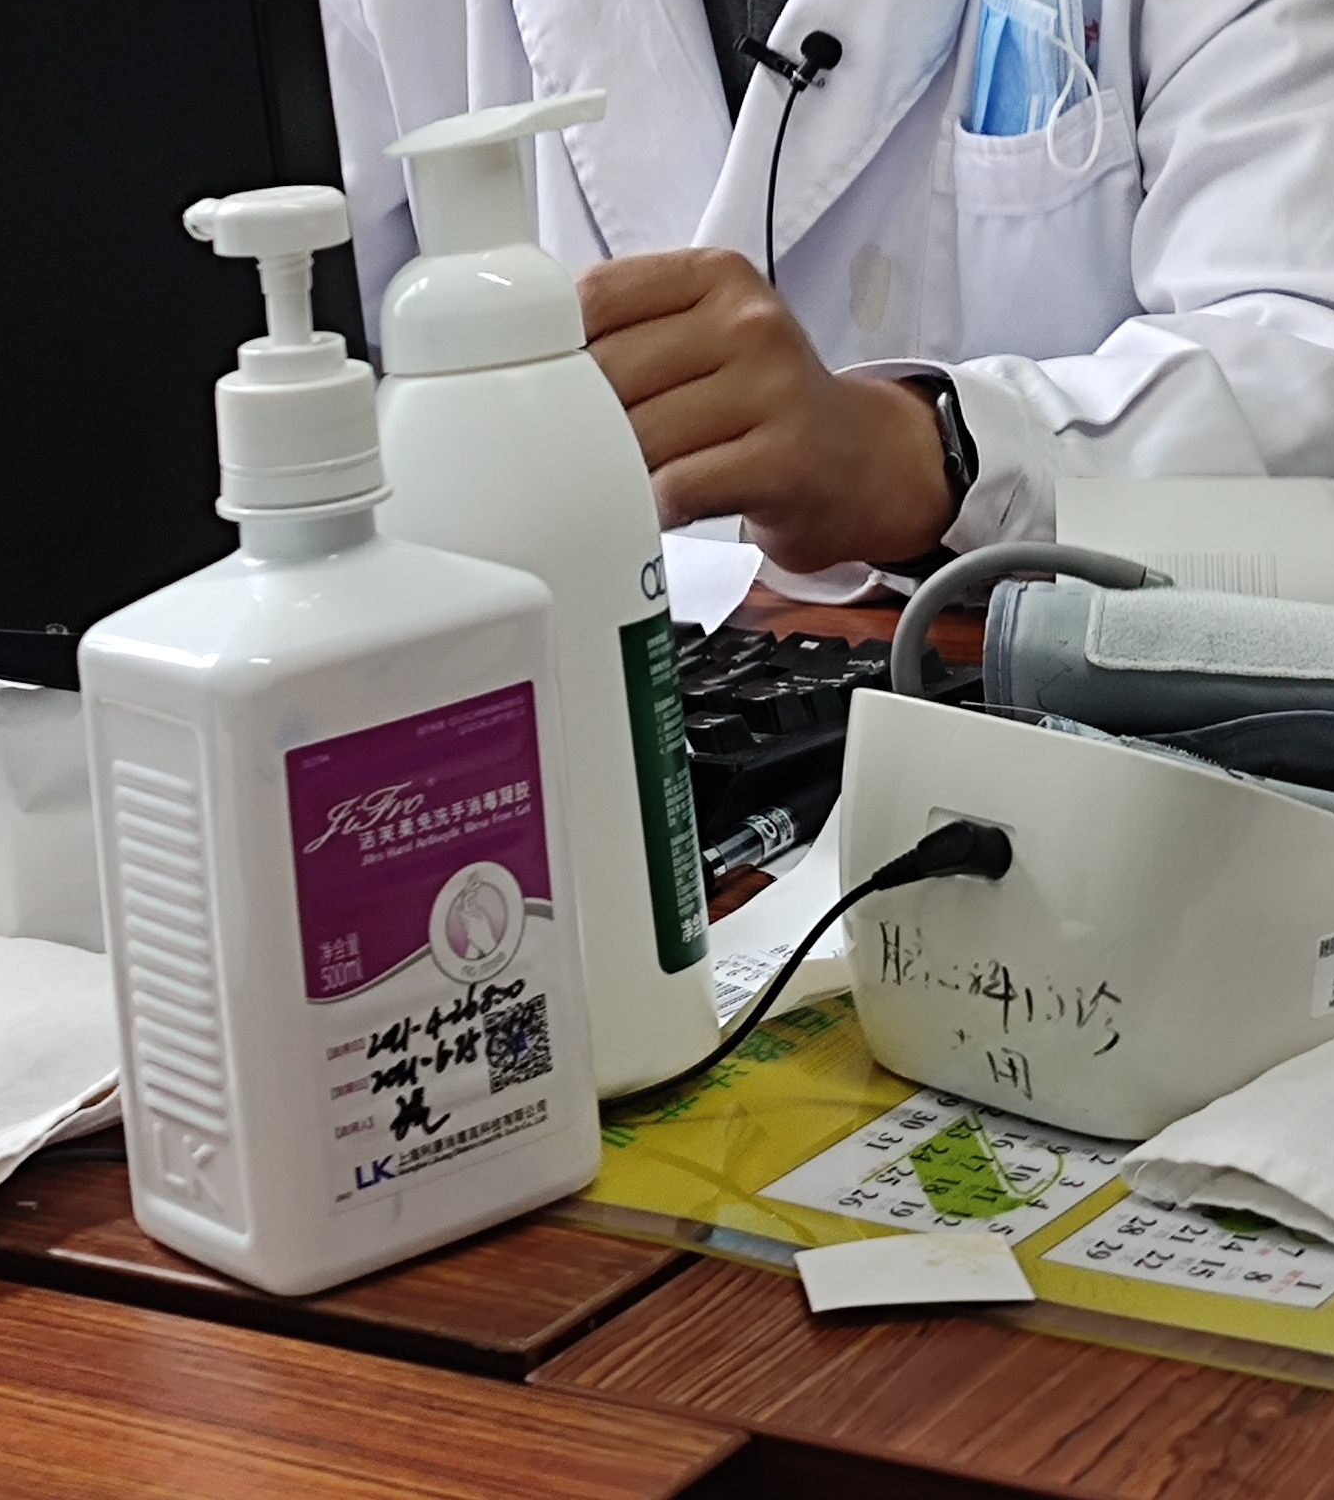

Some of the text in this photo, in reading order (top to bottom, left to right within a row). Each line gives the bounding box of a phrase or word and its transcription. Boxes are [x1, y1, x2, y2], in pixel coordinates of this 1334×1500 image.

[866, 1111, 937, 1150] 30 31
[355, 1154, 396, 1190] LK
[839, 1121, 982, 1208] 23 24 25 26
[890, 1132, 1029, 1217] 16 17 18 19
[934, 1145, 1071, 1227] 9 10 11 12
[989, 1154, 1116, 1235] 2 3 4 5
[1087, 1216, 1157, 1259] 28 29
[1134, 1225, 1208, 1269] 21 22
[1187, 1234, 1259, 1278] 14 15
[1244, 1248, 1305, 1282] 7 8
[1296, 1281, 1323, 1289] 1
